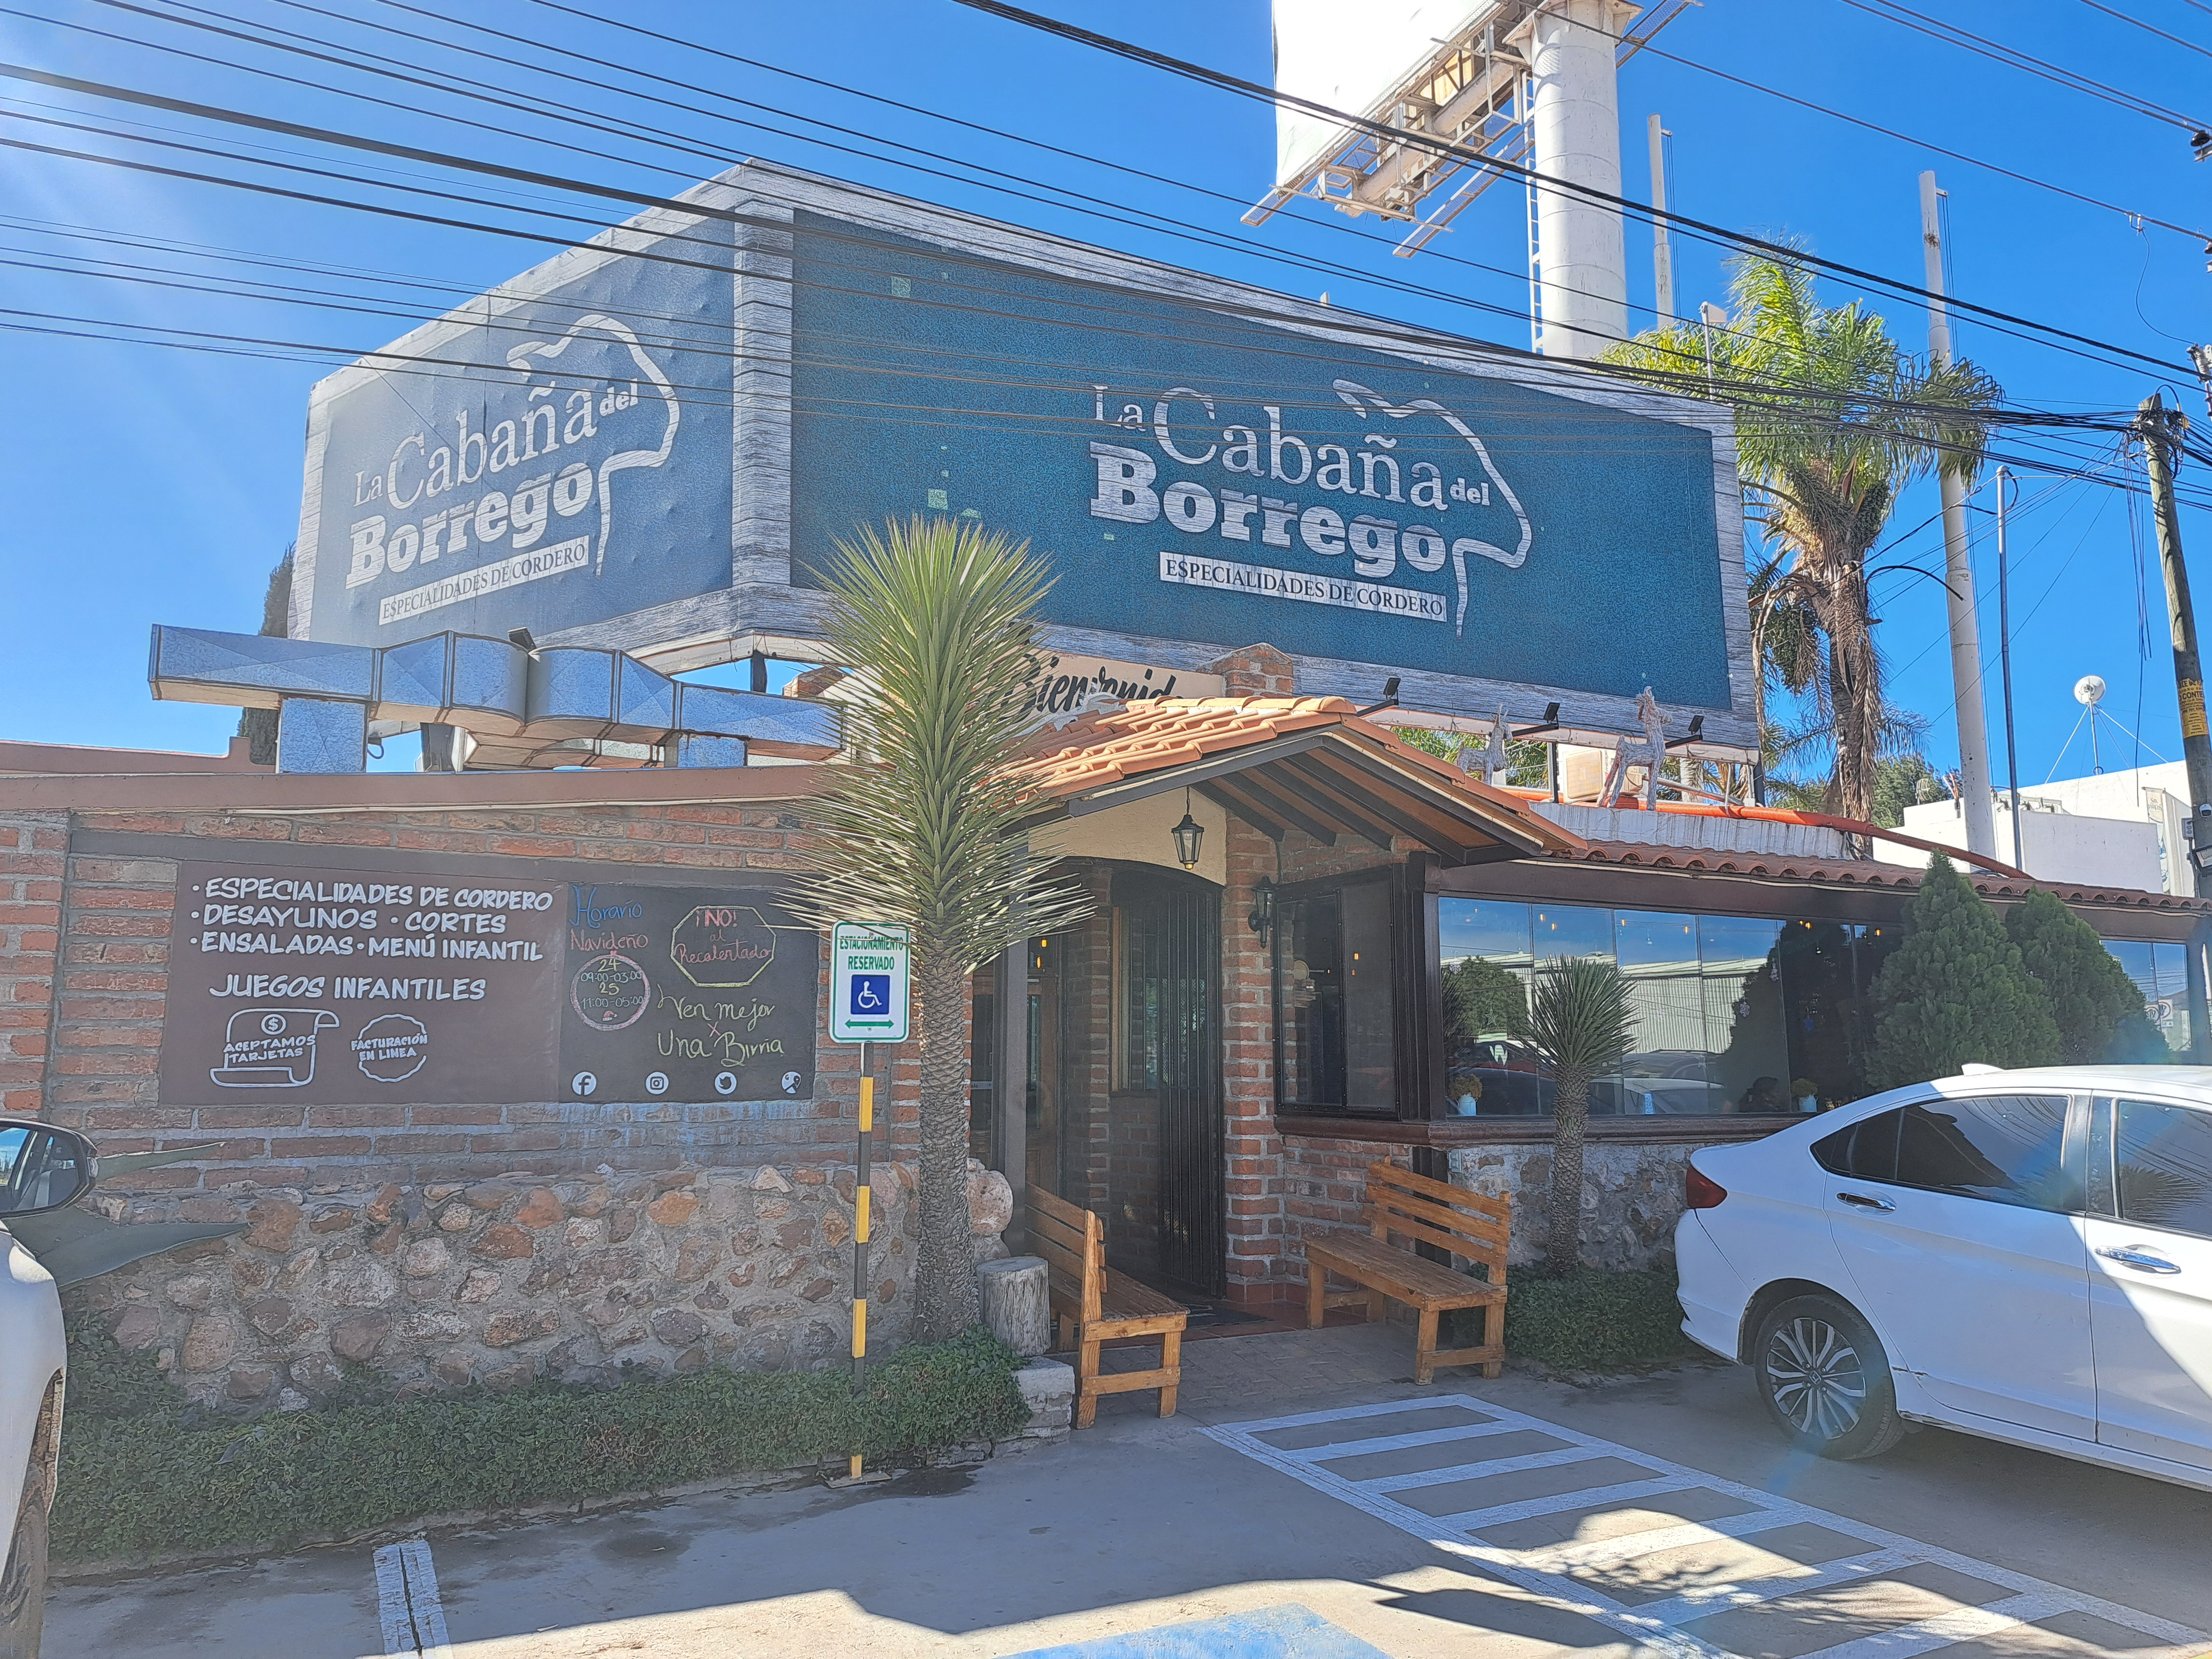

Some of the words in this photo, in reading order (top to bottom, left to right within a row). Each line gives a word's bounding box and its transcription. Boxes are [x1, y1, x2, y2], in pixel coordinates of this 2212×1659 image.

[354, 468, 383, 507] La
[387, 380, 597, 510] Cabaña
[599, 378, 639, 417] del
[1092, 384, 1146, 432] La
[1153, 386, 1448, 511] Cabaña
[1449, 477, 1490, 506] del
[1089, 441, 1446, 578] Borrego
[345, 462, 593, 589] Borrego
[383, 572, 488, 620] ESPECIALIDADES
[491, 565, 509, 587] DE
[511, 543, 586, 580] CORDERO
[1165, 559, 1325, 599] ESPECIALIDADES
[1327, 583, 1354, 602] DE
[1356, 586, 1443, 617] CORDERO
[205, 877, 413, 906] ESPECIALIDADES
[420, 886, 448, 907] DE
[453, 888, 553, 911] CORDERO
[203, 905, 377, 929] DESAYUNOS
[405, 912, 507, 934] CORTES
[696, 909, 738, 927] ¡NO!
[201, 931, 354, 956] ENSALADAS
[368, 933, 435, 958] MENÚ
[442, 939, 543, 962] INFANTIL
[570, 929, 649, 951] Navideño
[710, 929, 726, 941] al
[840, 936, 903, 951] ESTACIONAMIENTO
[598, 958, 621, 972] 24
[848, 956, 895, 970] RESERVADO
[210, 974, 325, 998] JUEGOS
[334, 977, 486, 1001] INFANTILES
[599, 983, 619, 995] 25
[657, 984, 711, 1019] Ven
[714, 998, 775, 1032] mejor
[223, 1035, 316, 1052] ACEPTAMOS
[229, 1047, 303, 1063] TARJETAS
[351, 1032, 428, 1051] FACTURACIÓN
[360, 1052, 375, 1062] EN
[378, 1047, 417, 1060] LINEA
[658, 1029, 712, 1059] Una
